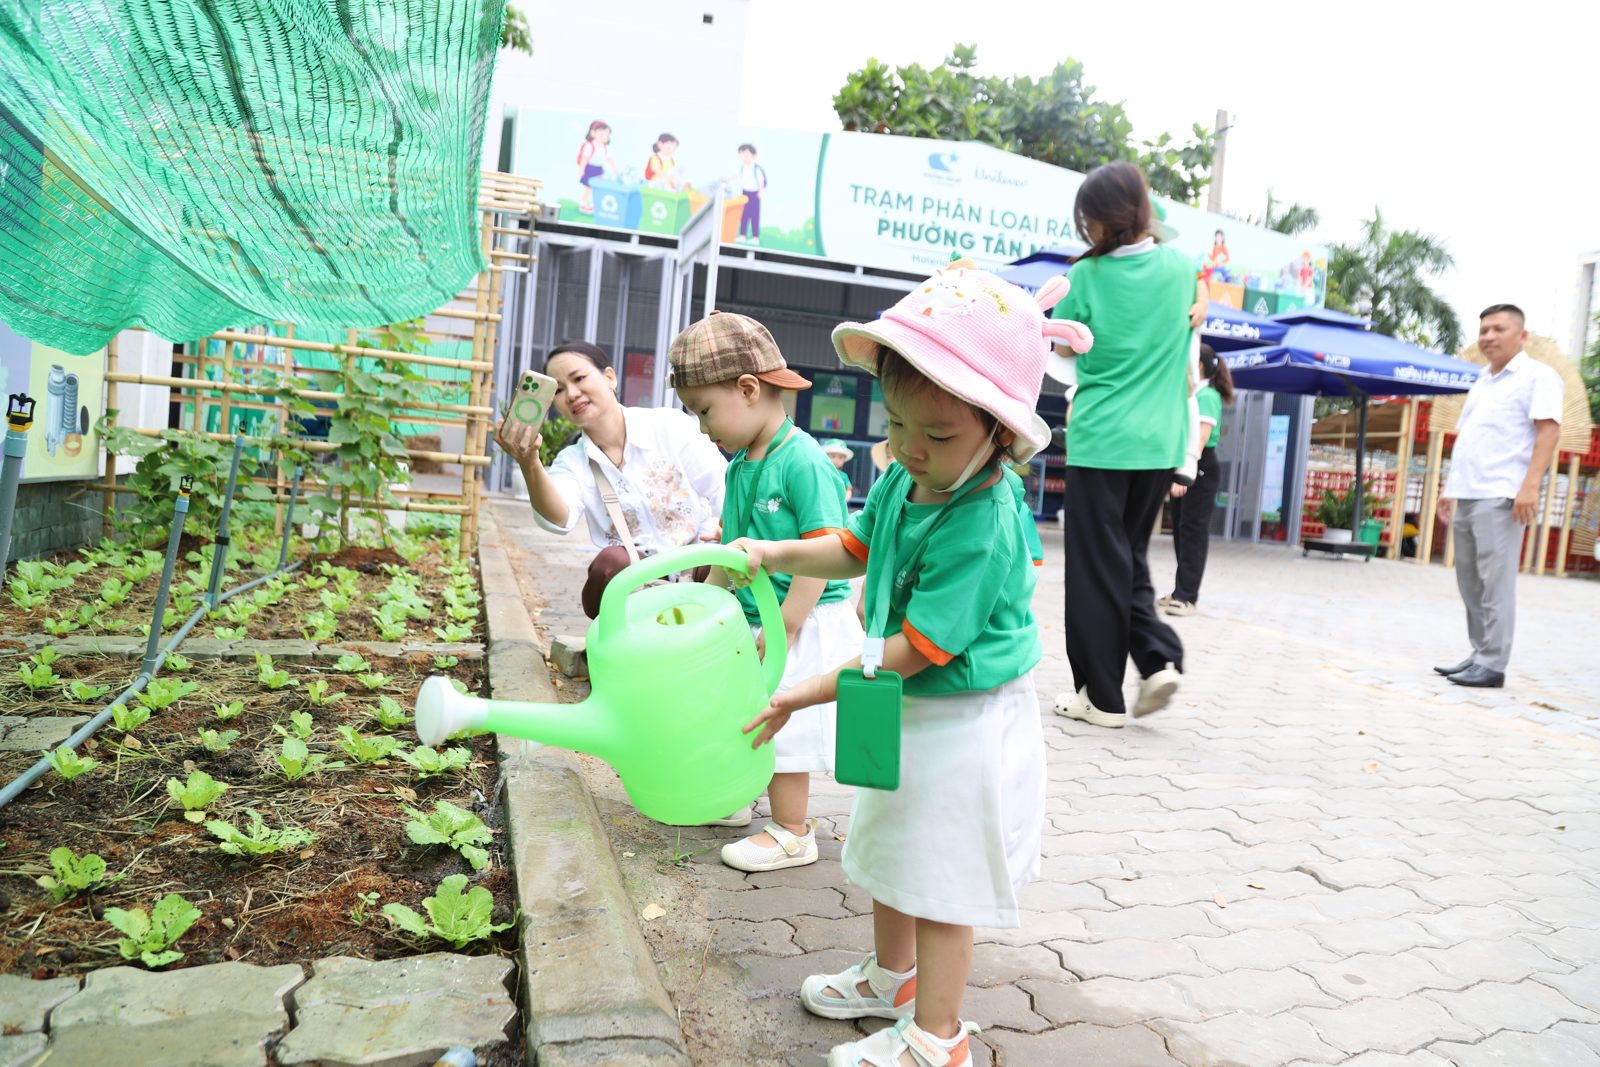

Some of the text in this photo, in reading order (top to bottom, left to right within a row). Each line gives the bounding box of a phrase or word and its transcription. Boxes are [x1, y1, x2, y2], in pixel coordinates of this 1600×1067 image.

[850, 184, 1079, 241] TRẠM PHÂN LOẠI RÁ
[877, 218, 975, 250] PHƯỜNG
[983, 233, 1023, 259] TÂN
[911, 253, 950, 267] Materia
[1200, 318, 1231, 335] UỐC
